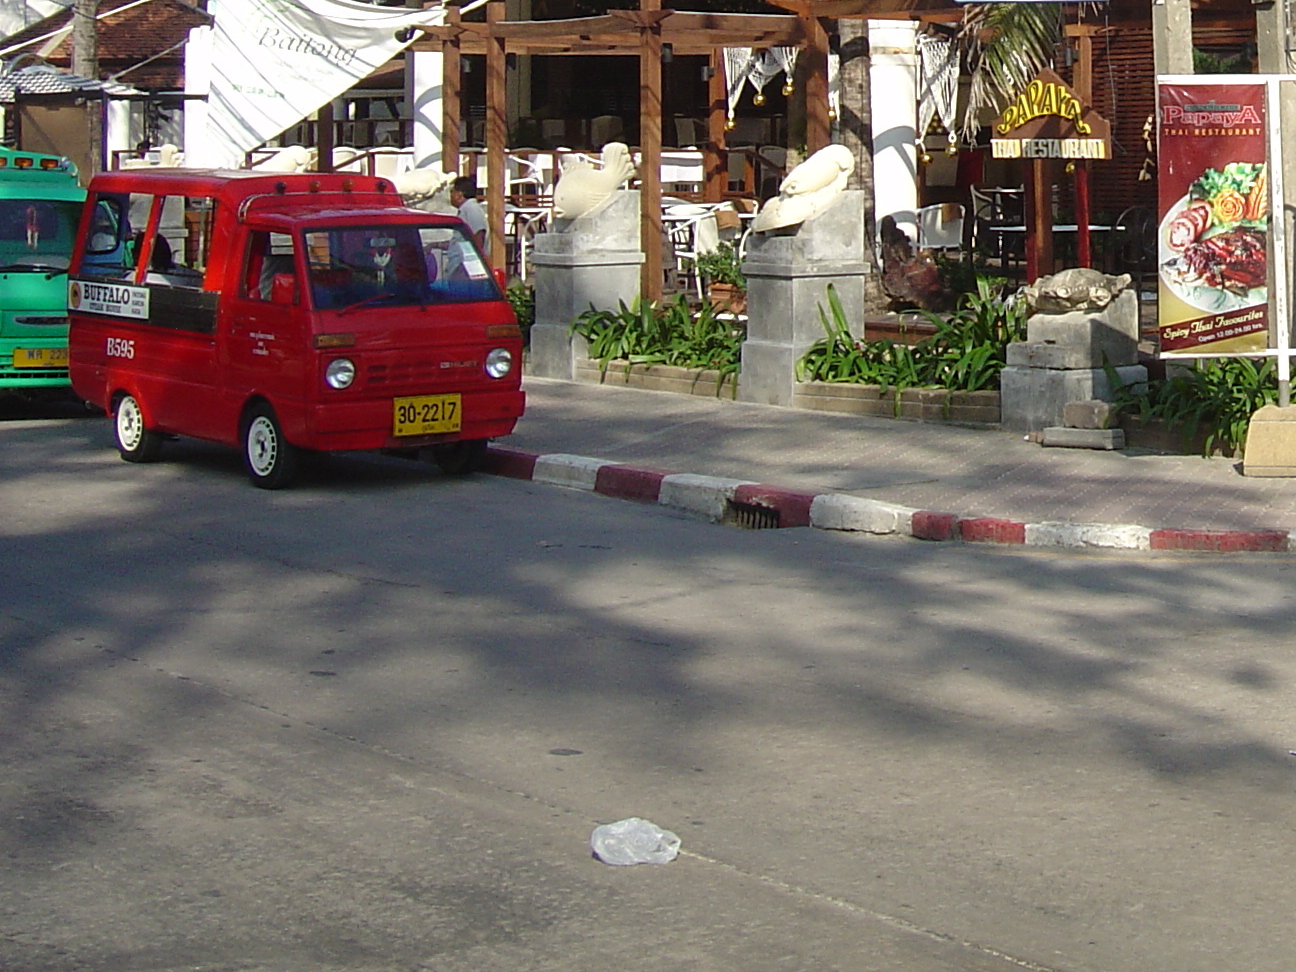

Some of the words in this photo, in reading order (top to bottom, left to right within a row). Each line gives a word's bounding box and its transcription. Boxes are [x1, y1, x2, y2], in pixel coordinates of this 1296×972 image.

[258, 26, 357, 67] Baitong
[1164, 128, 1189, 136] THAI
[1194, 128, 1261, 136] RESTAURANT
[990, 139, 1020, 158] THAI
[1021, 139, 1105, 159] RESTAURANT
[83, 283, 130, 305] BUFFALO
[1163, 327, 1191, 340] Spicy
[1190, 320, 1214, 333] Thai
[1214, 310, 1264, 328] Favourites
[107, 337, 135, 360] B595
[398, 399, 457, 425] 30-2217
